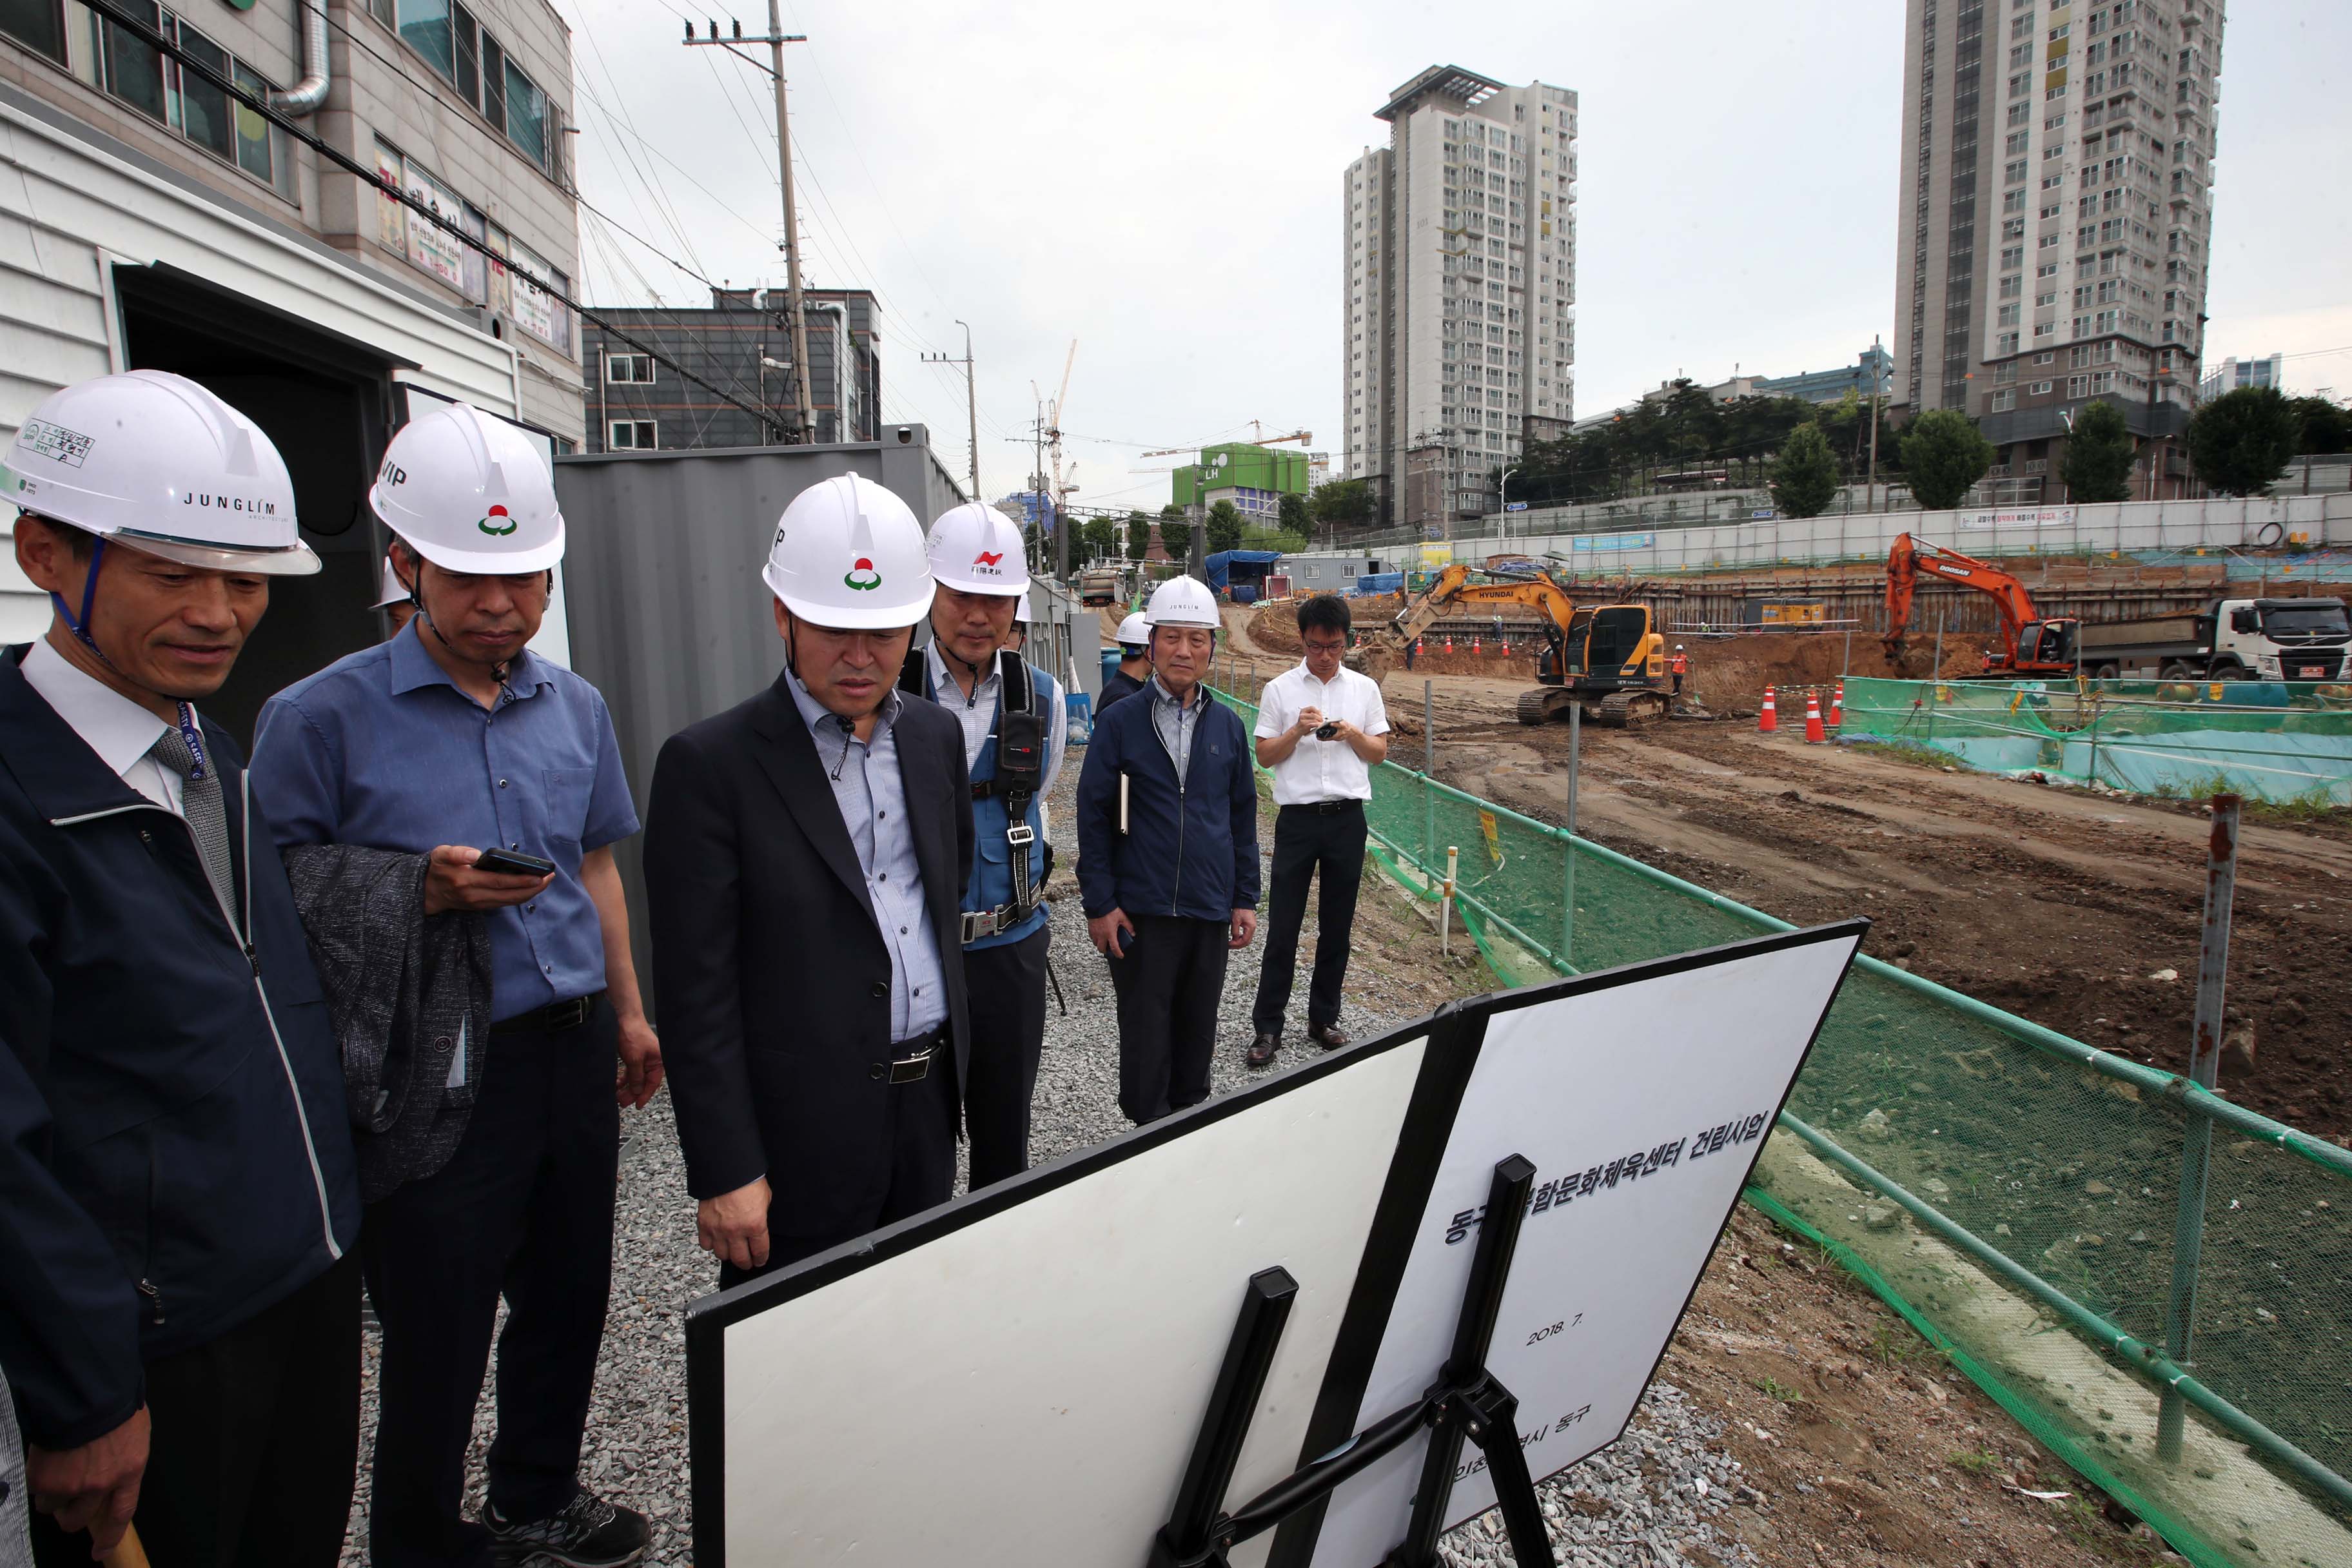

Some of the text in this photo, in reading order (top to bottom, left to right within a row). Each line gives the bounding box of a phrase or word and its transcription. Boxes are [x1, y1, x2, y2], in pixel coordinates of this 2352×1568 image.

[382, 455, 406, 486] VIP
[1206, 468, 1218, 480] LH
[184, 493, 275, 515] JUNGLIM
[1939, 565, 1970, 576] DOOSAN
[177, 701, 189, 727] SAFETY
[1522, 1137, 1687, 1219] 합문화체육센터
[1689, 1110, 1769, 1160] 건립사업
[1526, 1313, 1583, 1346] 2018. 7.
[1555, 1404, 1591, 1433] 동구
